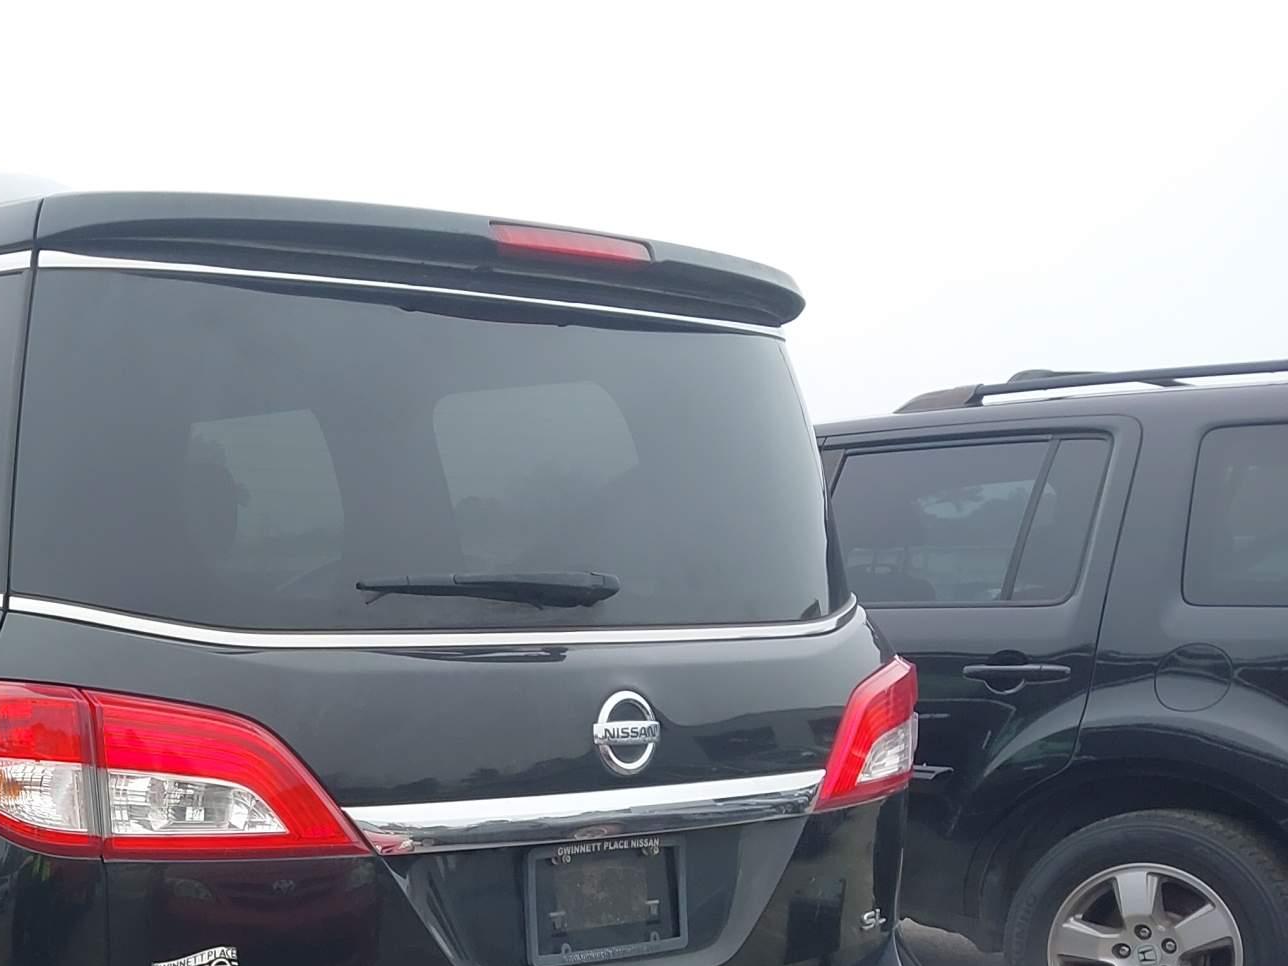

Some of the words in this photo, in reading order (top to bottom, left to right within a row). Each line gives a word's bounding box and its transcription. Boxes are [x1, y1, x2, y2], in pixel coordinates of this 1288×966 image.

[603, 724, 658, 739] NISSAN
[557, 842, 602, 856] GWINNETT
[603, 840, 629, 850] PLACE
[630, 838, 660, 848] NISSAN
[207, 947, 238, 961] PLACE
